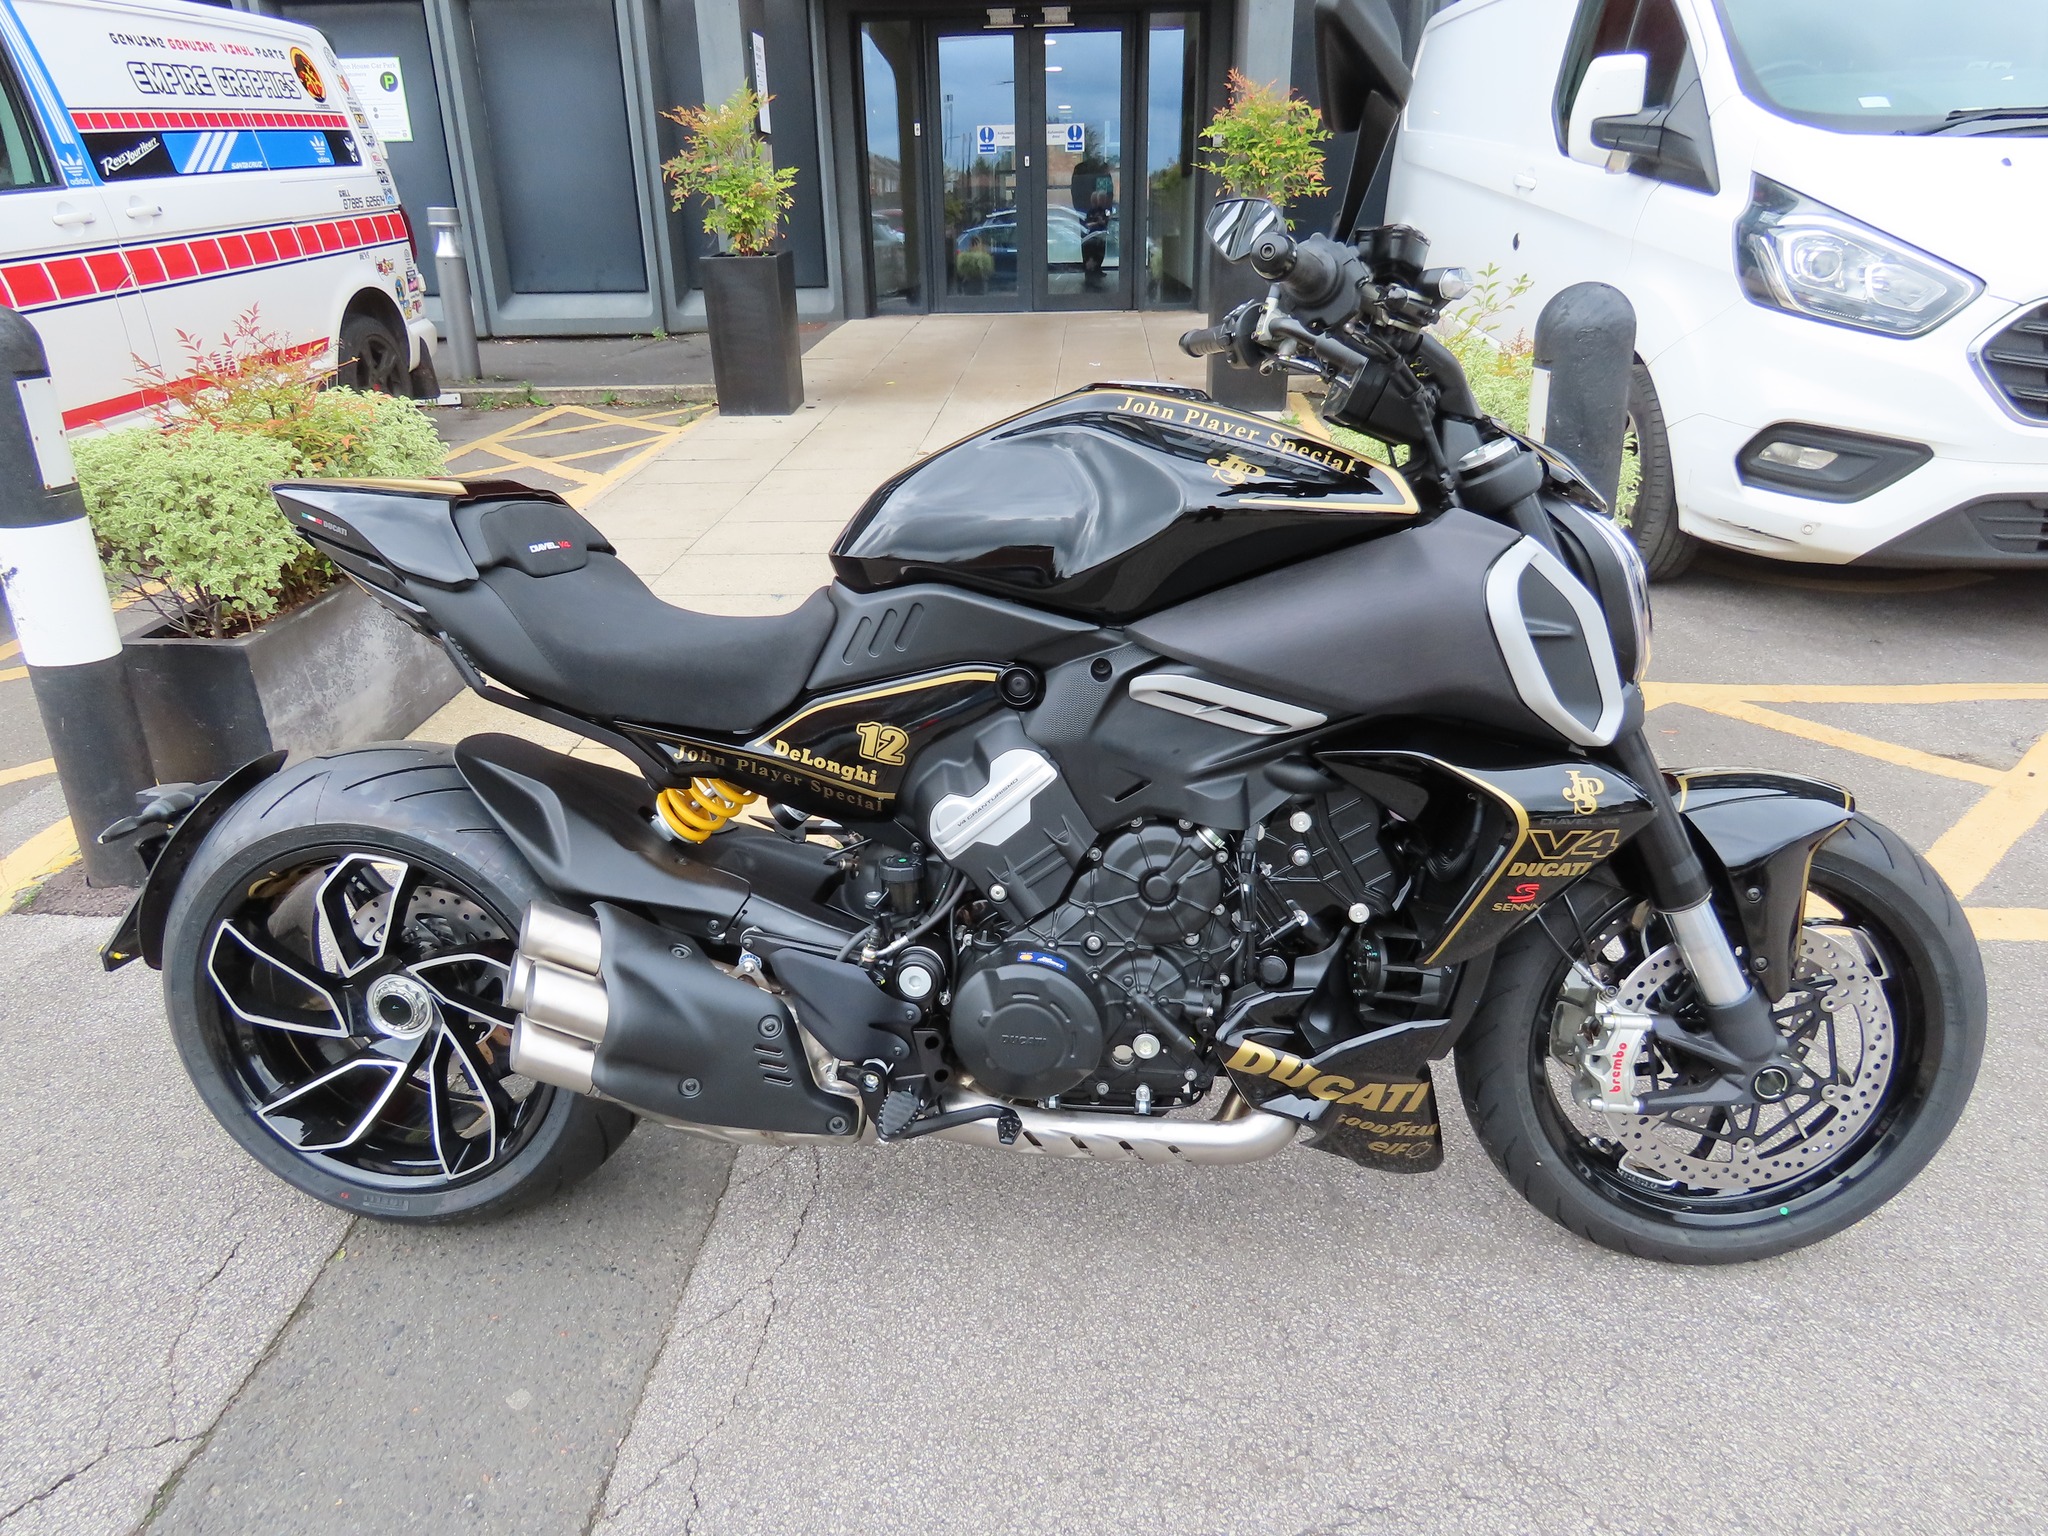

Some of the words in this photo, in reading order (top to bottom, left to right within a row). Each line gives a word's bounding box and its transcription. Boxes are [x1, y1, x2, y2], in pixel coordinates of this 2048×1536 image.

[220, 43, 255, 57] VINYL
[255, 47, 286, 60] PARTS
[127, 61, 215, 96] EMPIRE
[213, 67, 302, 100] GRAPHICS
[70, 177, 91, 185] adidas
[1117, 396, 1174, 420] John
[1182, 408, 1261, 441] Player
[1266, 431, 1355, 475] Special
[323, 520, 348, 536] DUCATI
[529, 541, 560, 553] DIAVEL
[856, 722, 909, 767] 12
[673, 744, 726, 767] John
[736, 758, 803, 786] Player
[810, 780, 884, 812] Special
[773, 739, 878, 786] DeLonghi
[967, 778, 1019, 820] GRANTURISMO
[1526, 829, 1620, 859] V4
[1507, 861, 1593, 877] DUCATI
[1001, 1034, 1047, 1046] DUCATI
[1226, 1039, 1431, 1113] DUCATI
[1609, 1042, 1628, 1093] brembo
[1368, 1141, 1412, 1155] elf
